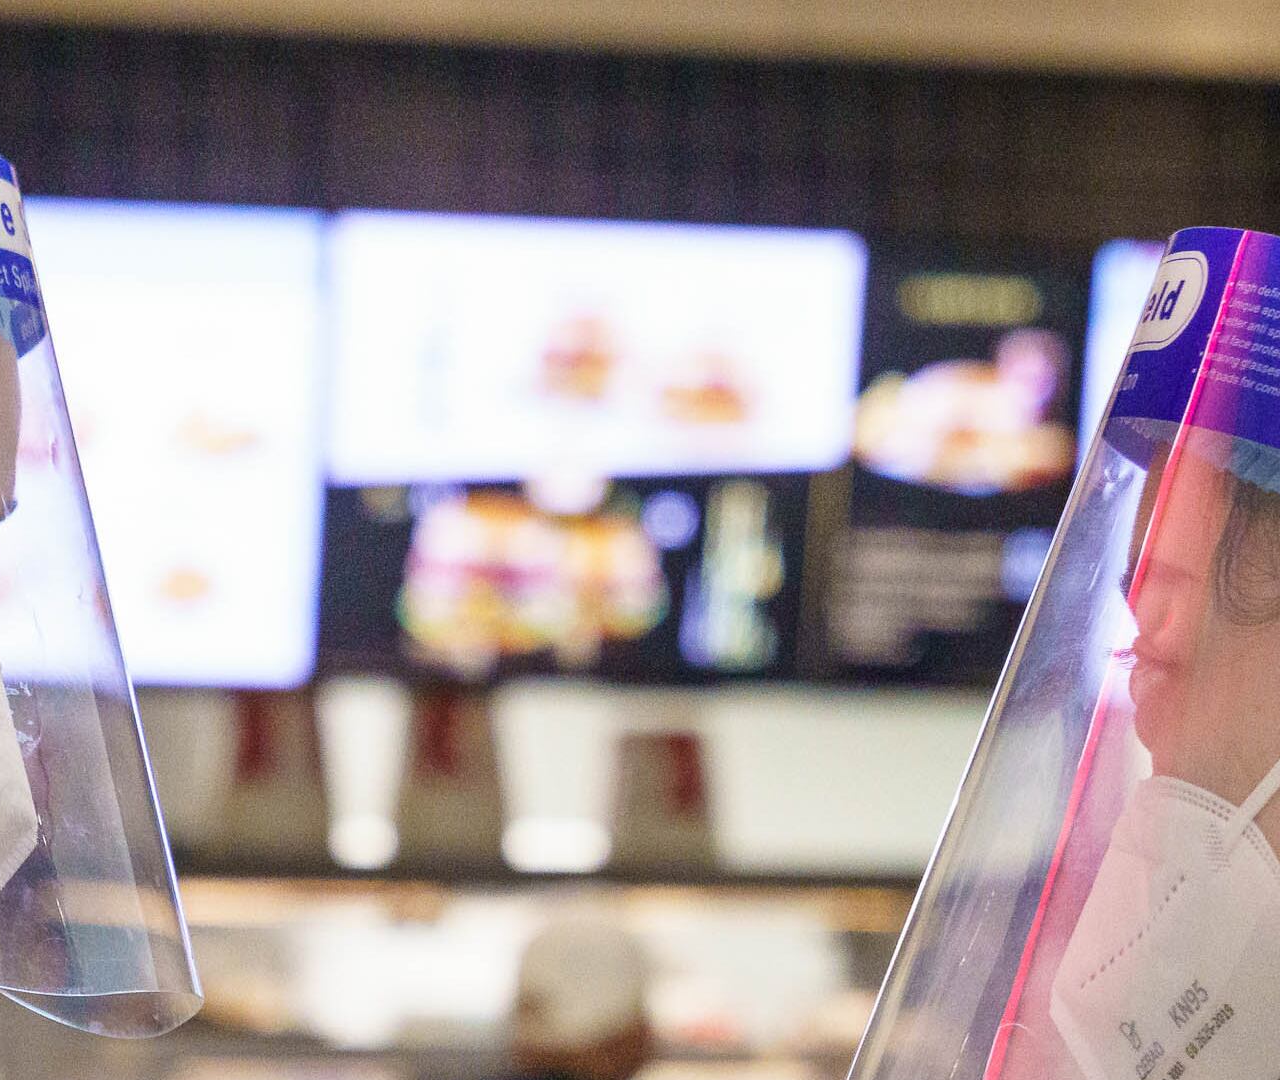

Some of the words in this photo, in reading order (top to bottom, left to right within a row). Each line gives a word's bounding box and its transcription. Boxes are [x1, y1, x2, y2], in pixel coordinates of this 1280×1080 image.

[1247, 322, 1268, 334] anti
[1241, 376, 1255, 388] for
[1168, 979, 1209, 1028] KN95
